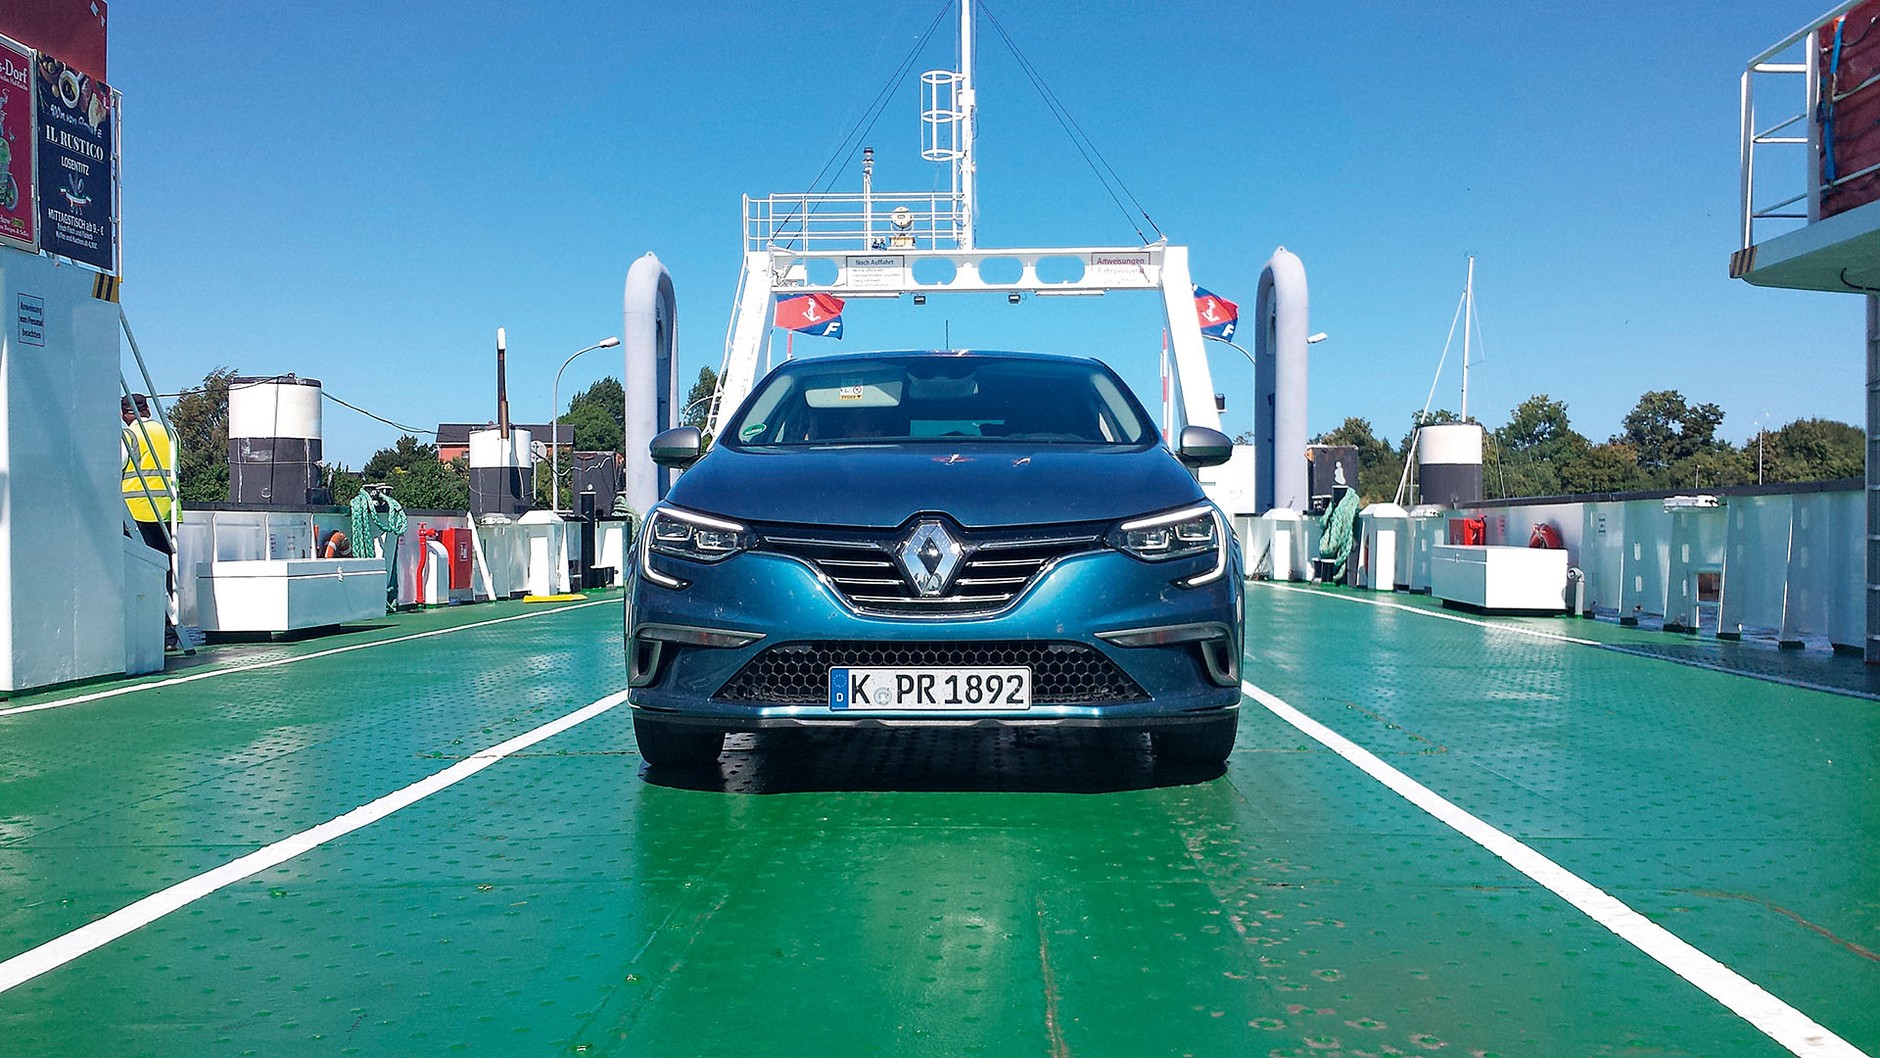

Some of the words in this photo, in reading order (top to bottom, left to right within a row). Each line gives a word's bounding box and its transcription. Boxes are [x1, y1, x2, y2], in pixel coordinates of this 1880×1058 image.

[46, 124, 58, 143] IL
[60, 130, 104, 161] RUSTICO
[61, 155, 89, 176] LOSENTITZ
[48, 207, 86, 230] MITTAGSTISCH
[86, 221, 93, 232] ab
[1096, 257, 1145, 265] Anweisungen
[822, 321, 841, 336] F
[1221, 323, 1235, 337] F
[836, 692, 844, 702] D
[851, 674, 871, 704] K
[896, 674, 937, 704] PR
[945, 674, 1025, 704] 1892
